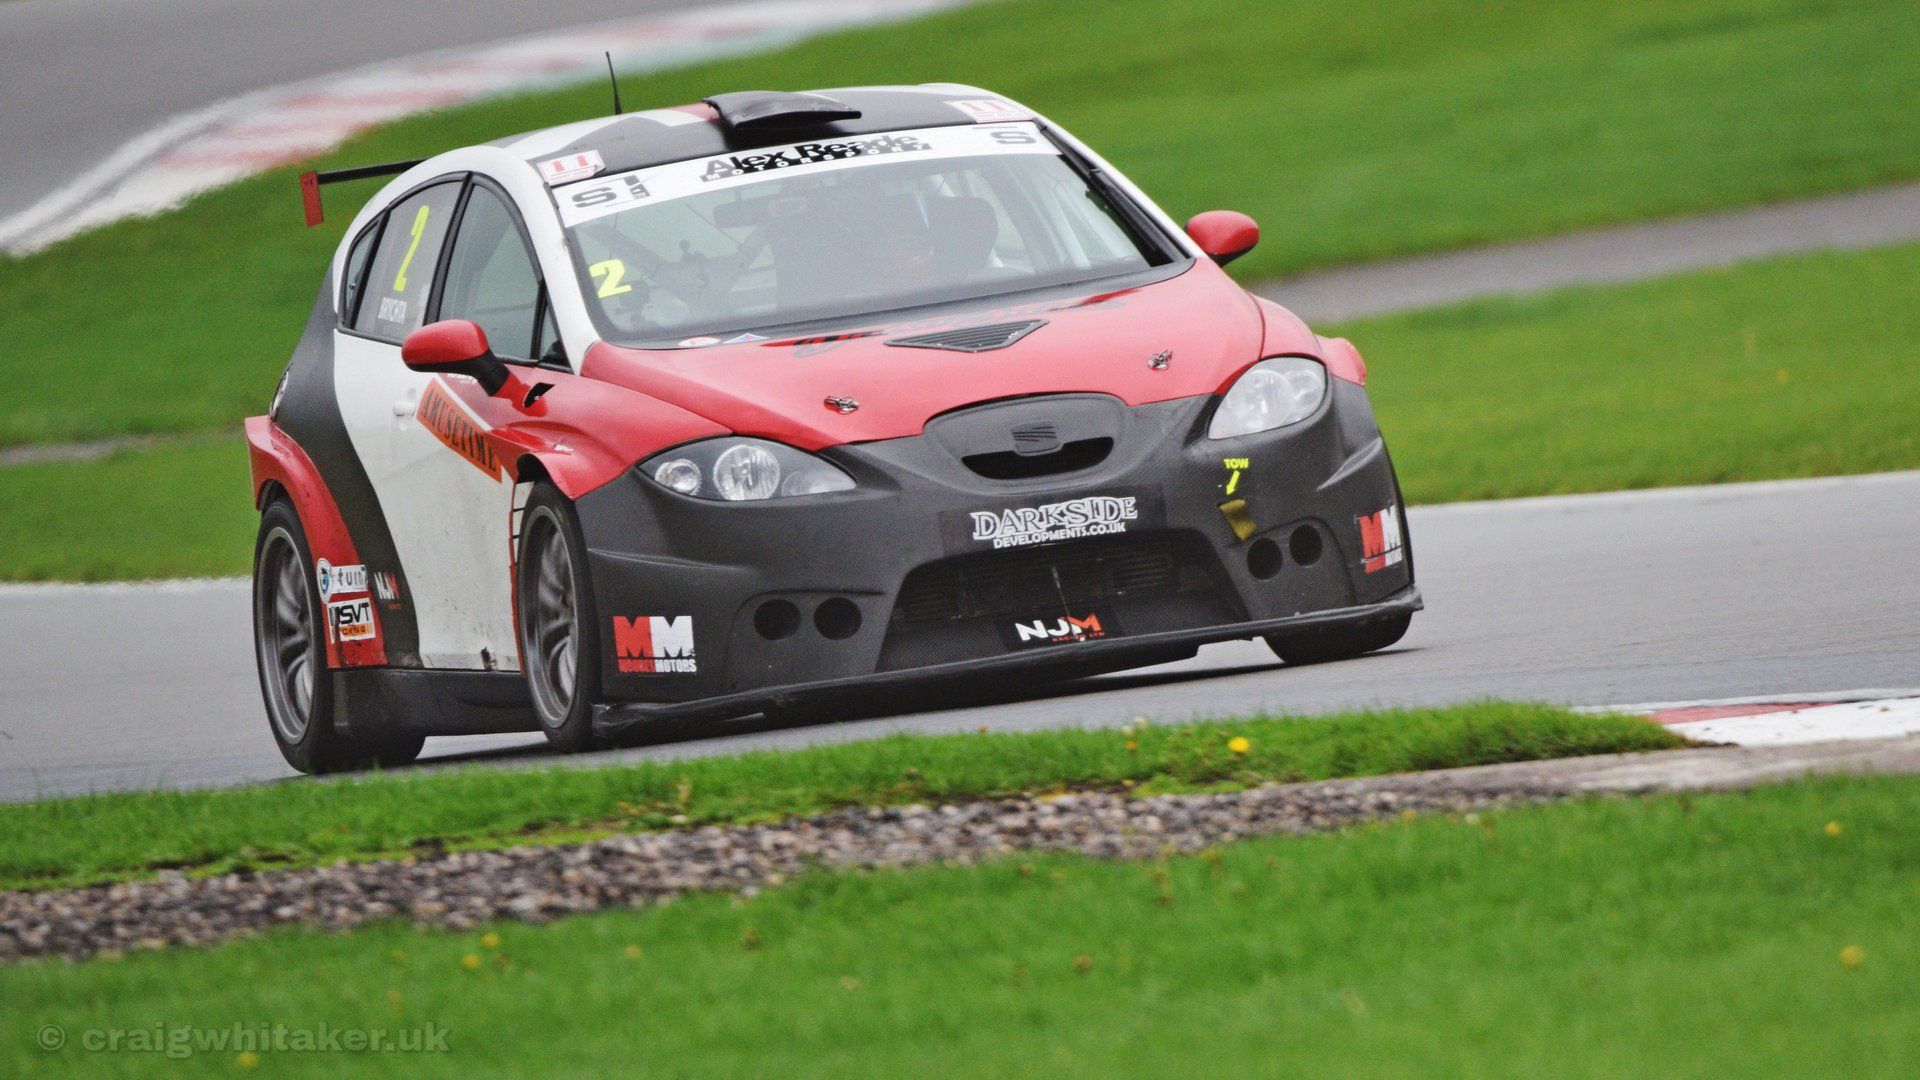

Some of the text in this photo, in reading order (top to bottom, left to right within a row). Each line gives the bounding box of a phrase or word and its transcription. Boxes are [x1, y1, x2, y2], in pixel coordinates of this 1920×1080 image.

[705, 134, 920, 178] Alex Reade
[393, 205, 429, 292] 2
[589, 259, 632, 298] 2
[422, 387, 497, 473] AMUSETIME
[1223, 458, 1249, 469] TOW
[970, 497, 1138, 540] DARKSIDE
[993, 522, 1127, 549] DEVELOPMENTS.CO.UK
[613, 615, 694, 657] MM
[1014, 612, 1102, 641] NJM
[654, 659, 697, 673] MOTORS
